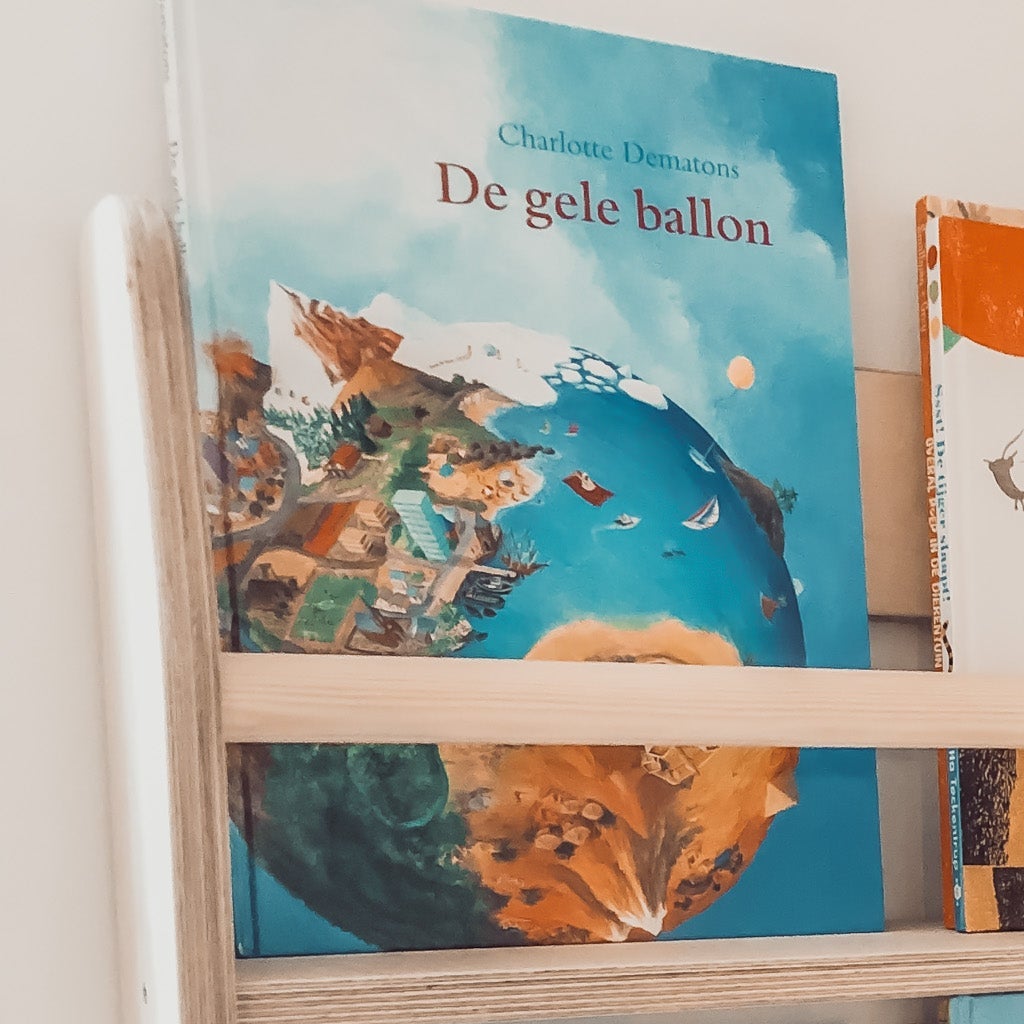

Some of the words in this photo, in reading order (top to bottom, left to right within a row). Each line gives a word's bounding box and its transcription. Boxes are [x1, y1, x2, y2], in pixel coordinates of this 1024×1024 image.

[498, 121, 613, 160] Charlotte
[623, 140, 740, 180] Dematons
[435, 161, 508, 212] De
[525, 181, 621, 230] gele
[633, 188, 774, 246] ballon
[925, 437, 937, 493] OVERAL
[930, 557, 939, 577] DE
